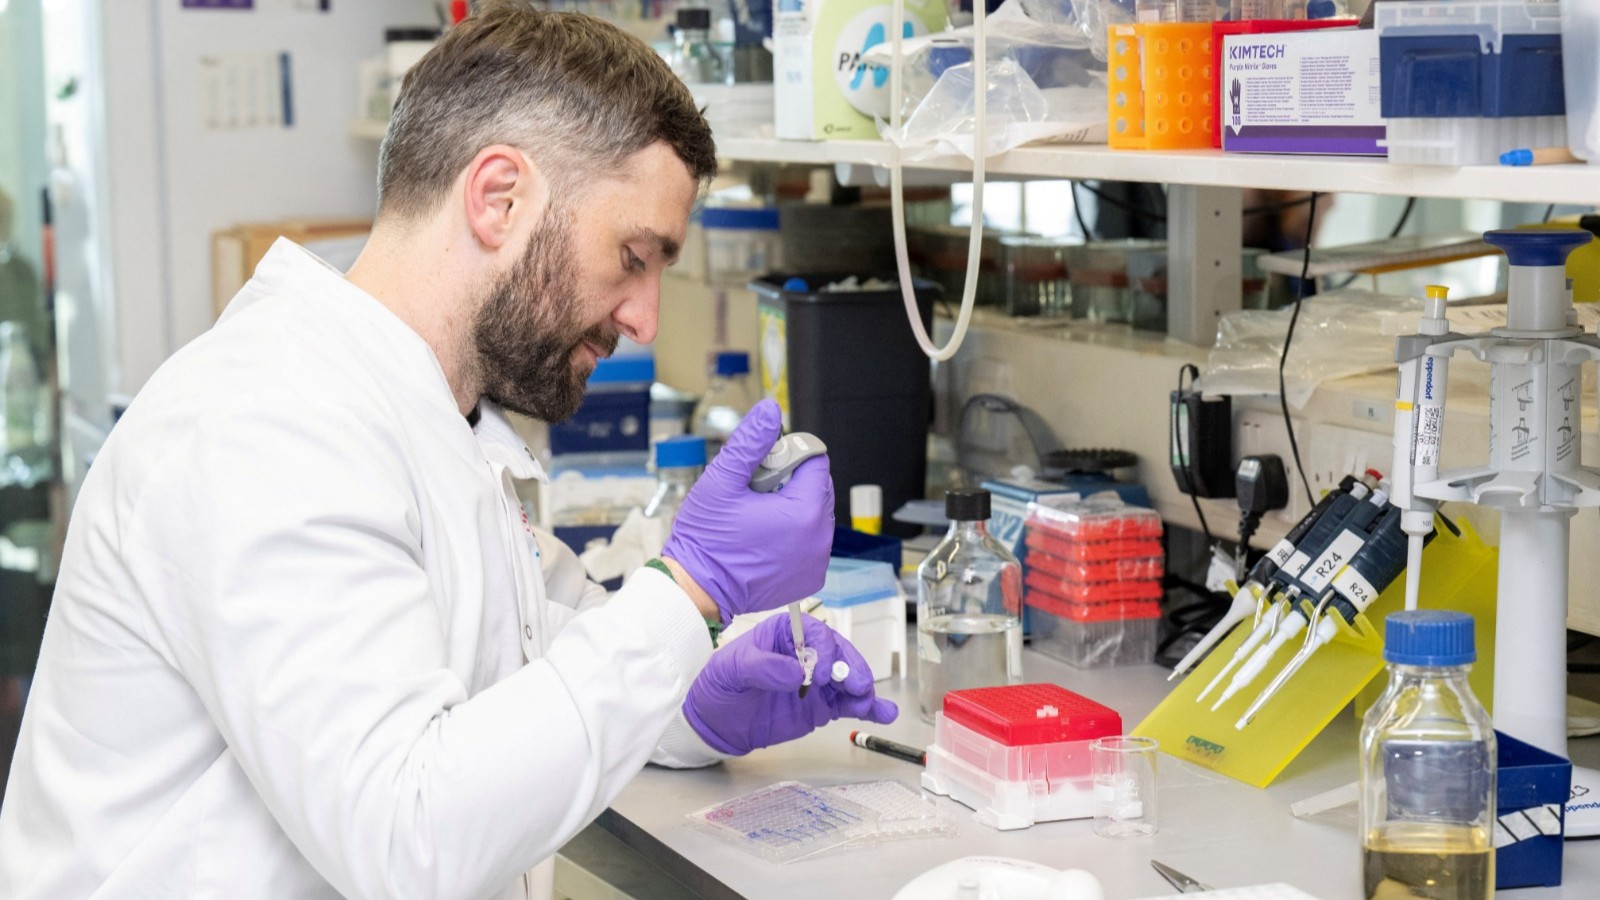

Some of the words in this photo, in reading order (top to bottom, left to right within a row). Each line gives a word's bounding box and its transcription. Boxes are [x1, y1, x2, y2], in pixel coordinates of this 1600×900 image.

[1229, 44, 1285, 60] KIMTECH
[1229, 63, 1244, 72] Purple
[1261, 62, 1277, 70] Gloves
[1232, 115, 1241, 126] 100
[1425, 356, 1434, 401] eppendorf
[1315, 551, 1343, 578] R24
[1349, 582, 1369, 603] R24
